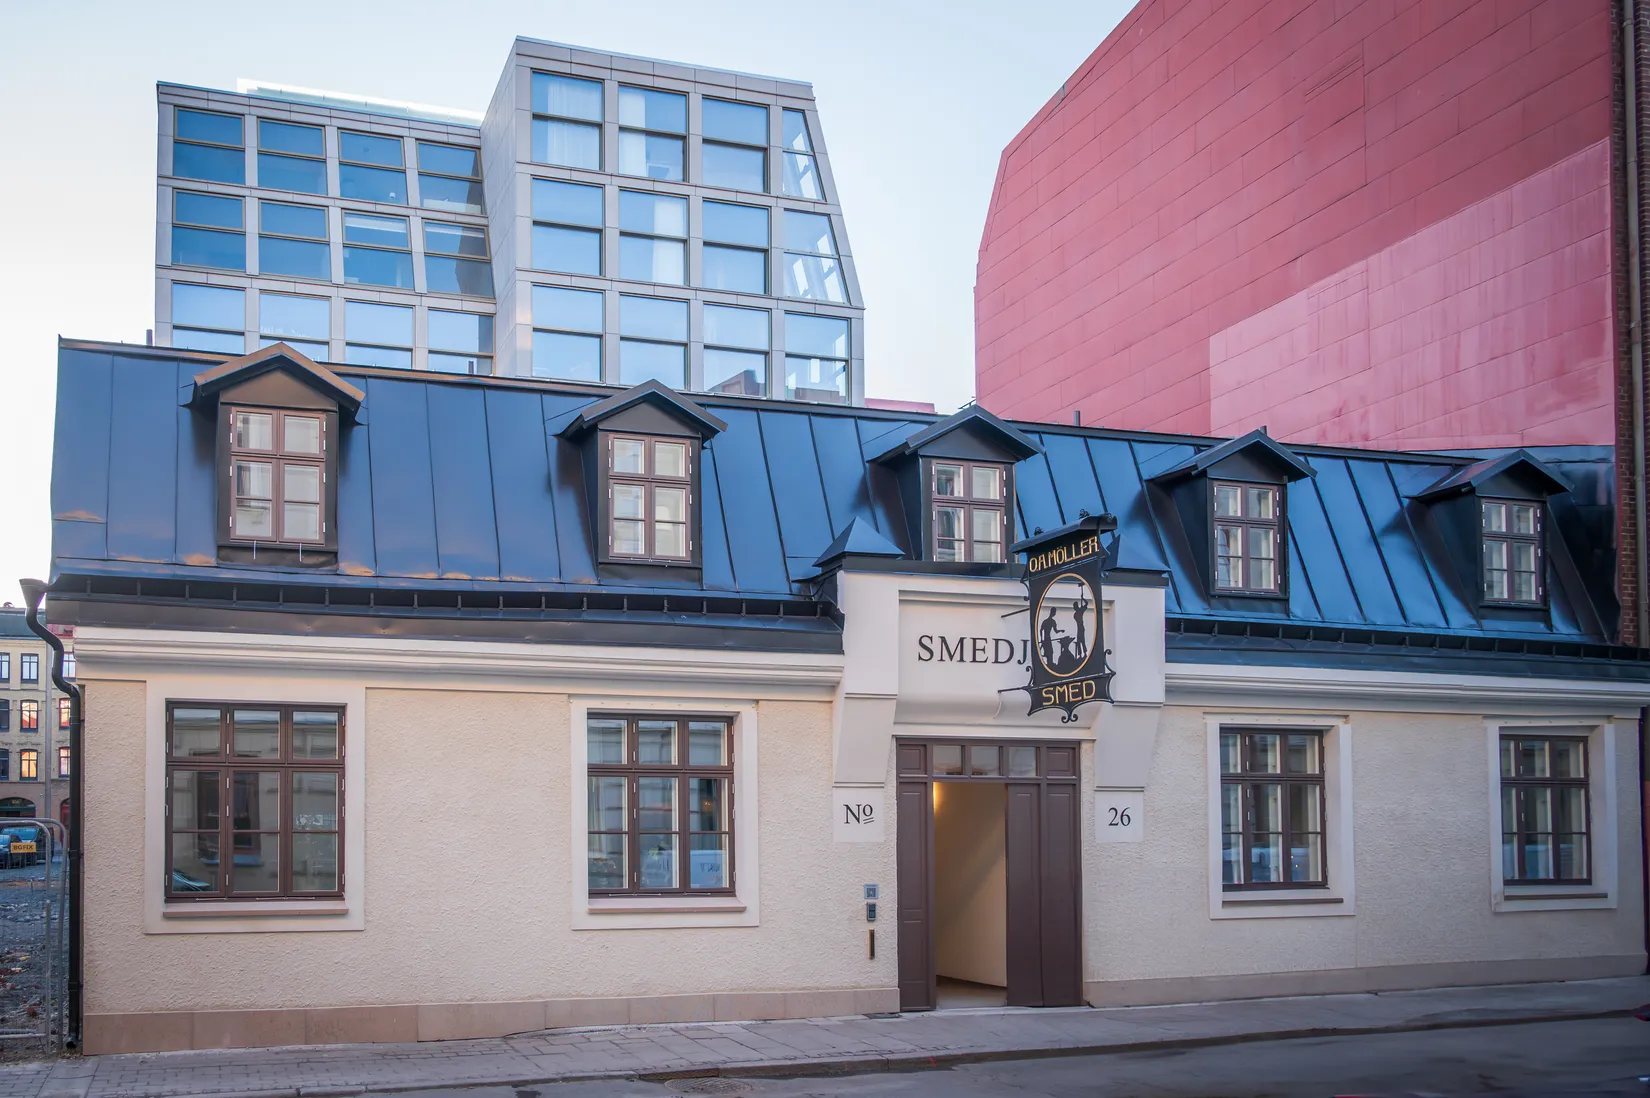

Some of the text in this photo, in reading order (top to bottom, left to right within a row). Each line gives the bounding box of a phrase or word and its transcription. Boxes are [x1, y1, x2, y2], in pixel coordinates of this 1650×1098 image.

[917, 634, 1079, 665] SMEDJ
[1042, 680, 1096, 705] SMED
[1108, 806, 1131, 827] 26
